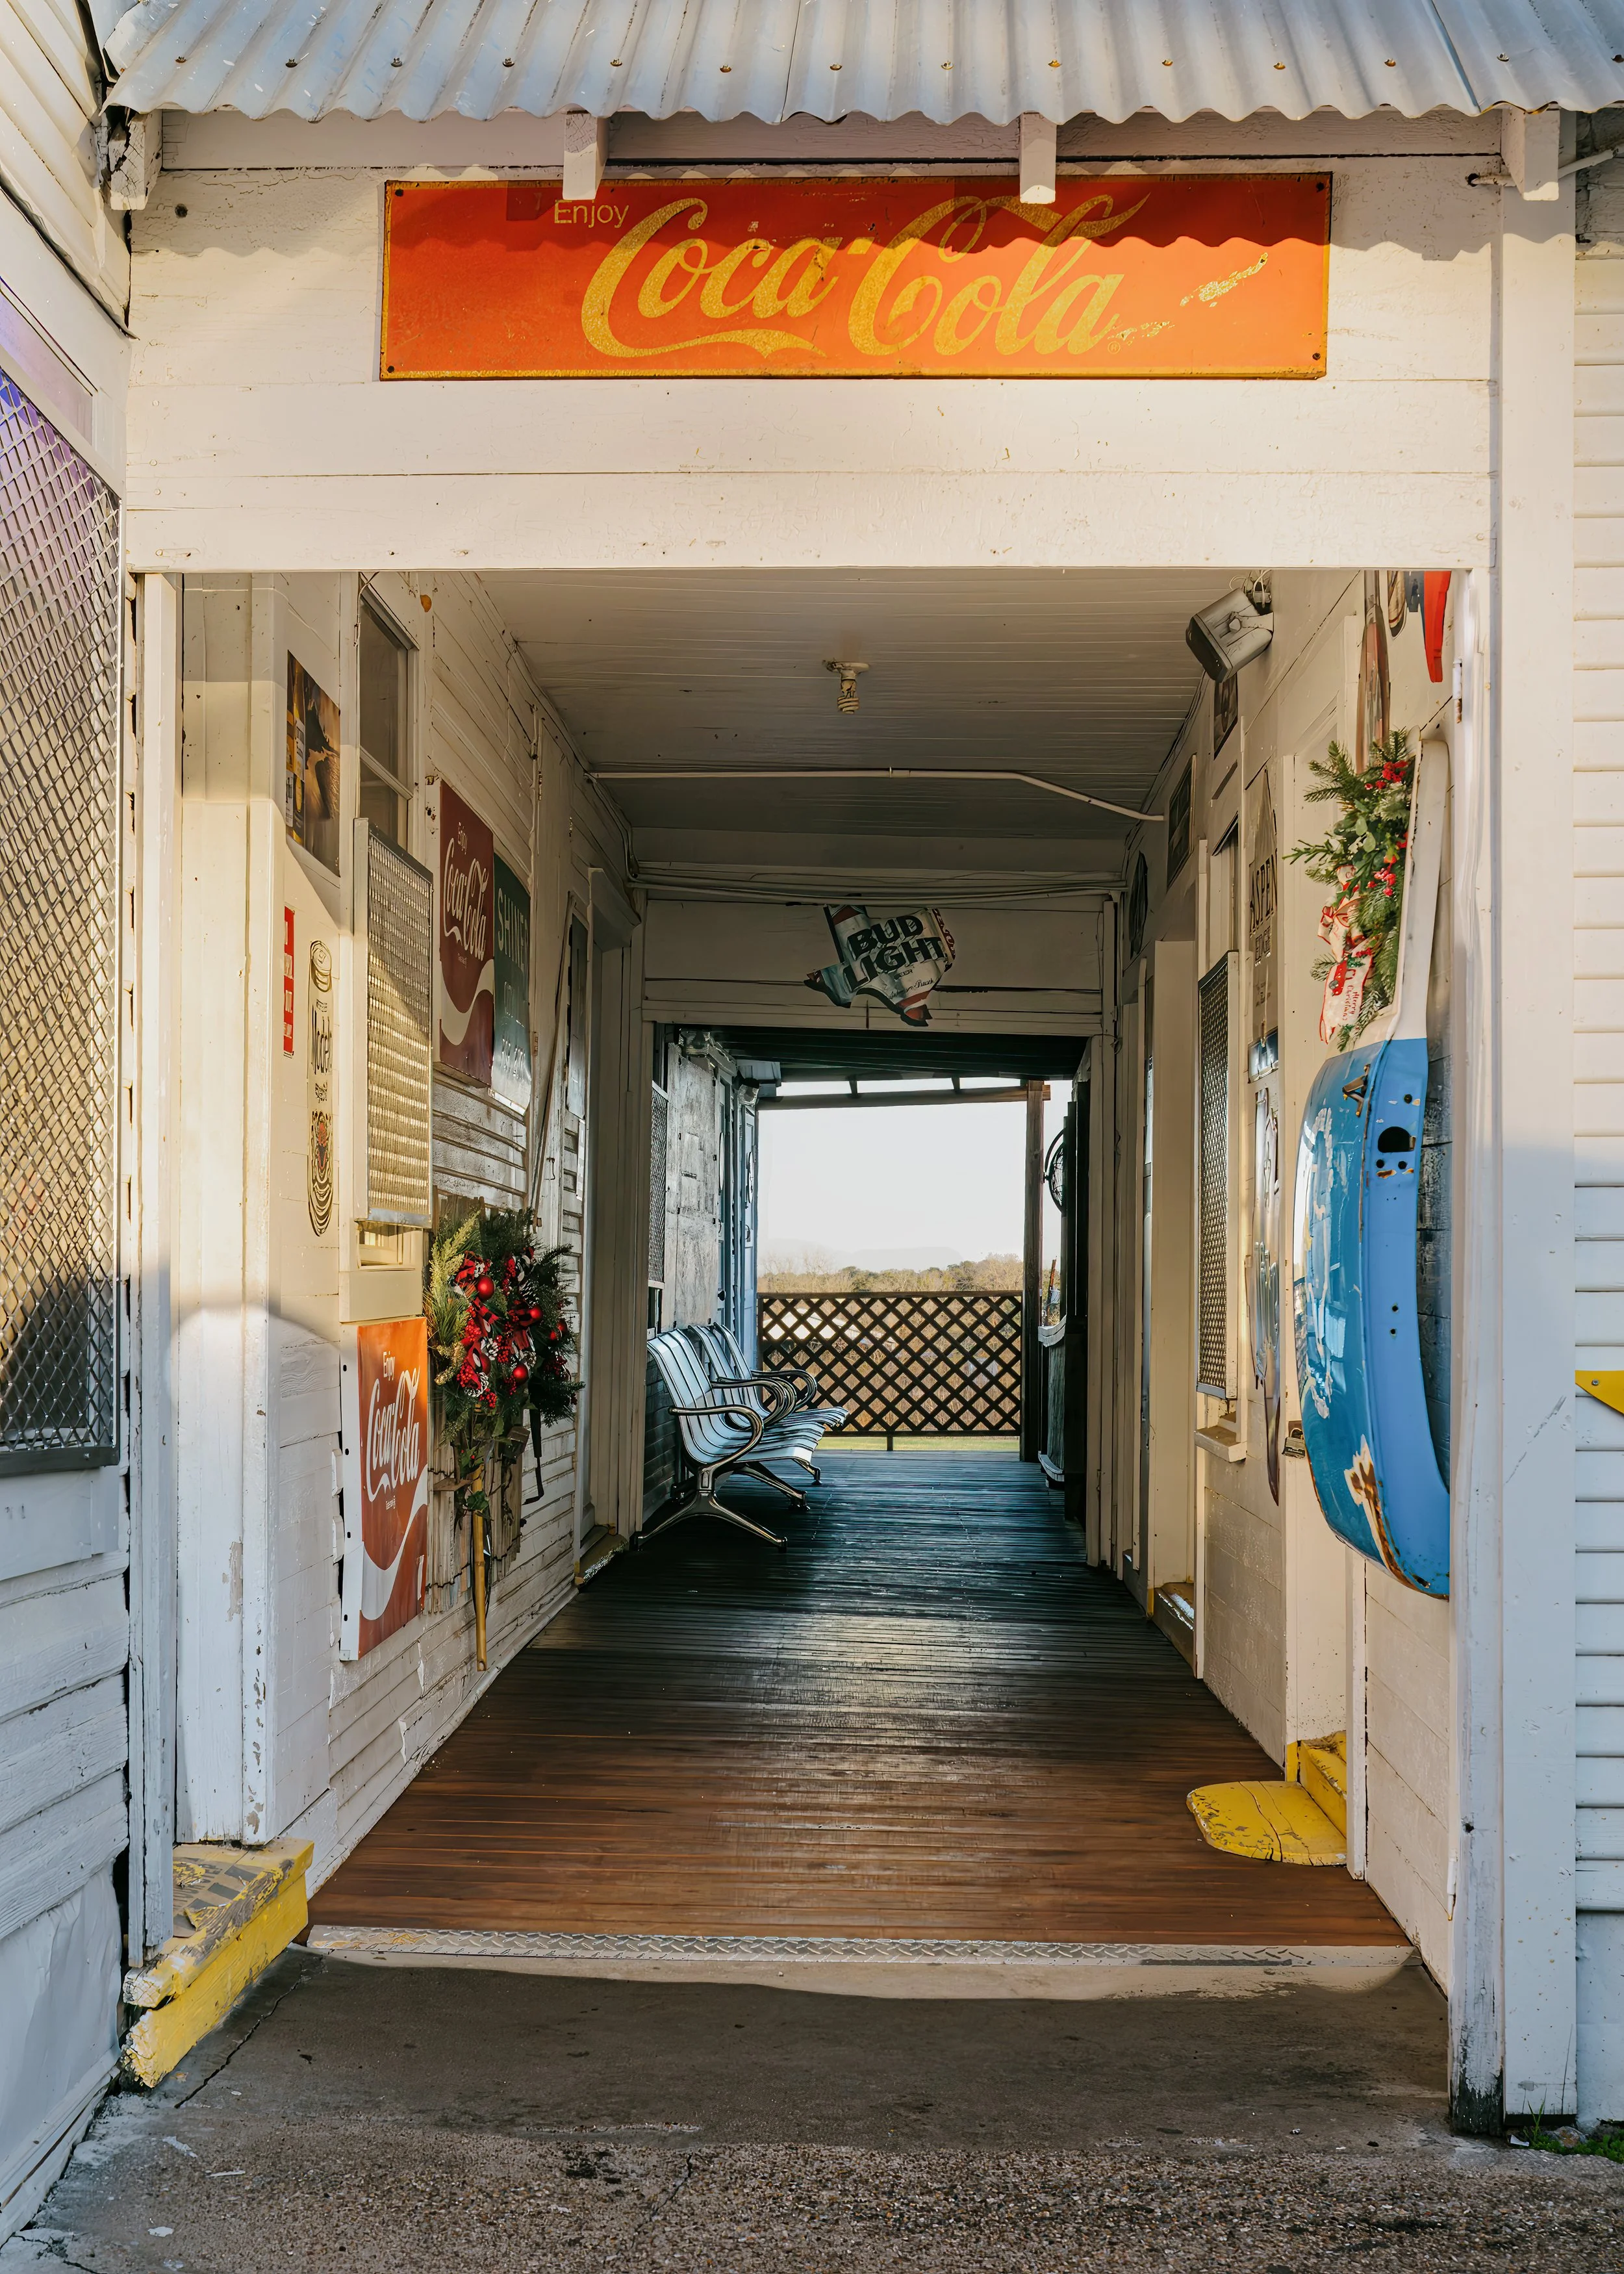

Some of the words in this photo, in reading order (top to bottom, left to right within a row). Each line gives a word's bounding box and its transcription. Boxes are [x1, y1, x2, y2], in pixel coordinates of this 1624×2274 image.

[554, 199, 629, 229] Enjoy
[581, 192, 1152, 359] Coca-Cola
[444, 837, 489, 962] Coca-Cola
[1250, 847, 1278, 938] ASPEN
[498, 886, 529, 976] SHINER
[843, 936, 948, 994] LIGHT
[847, 915, 924, 962] BUD
[1255, 925, 1271, 963] EDGE
[311, 1003, 333, 1075] Modelo
[383, 1351, 396, 1381] Enjoy
[366, 1366, 421, 1502] Coca-Cola
